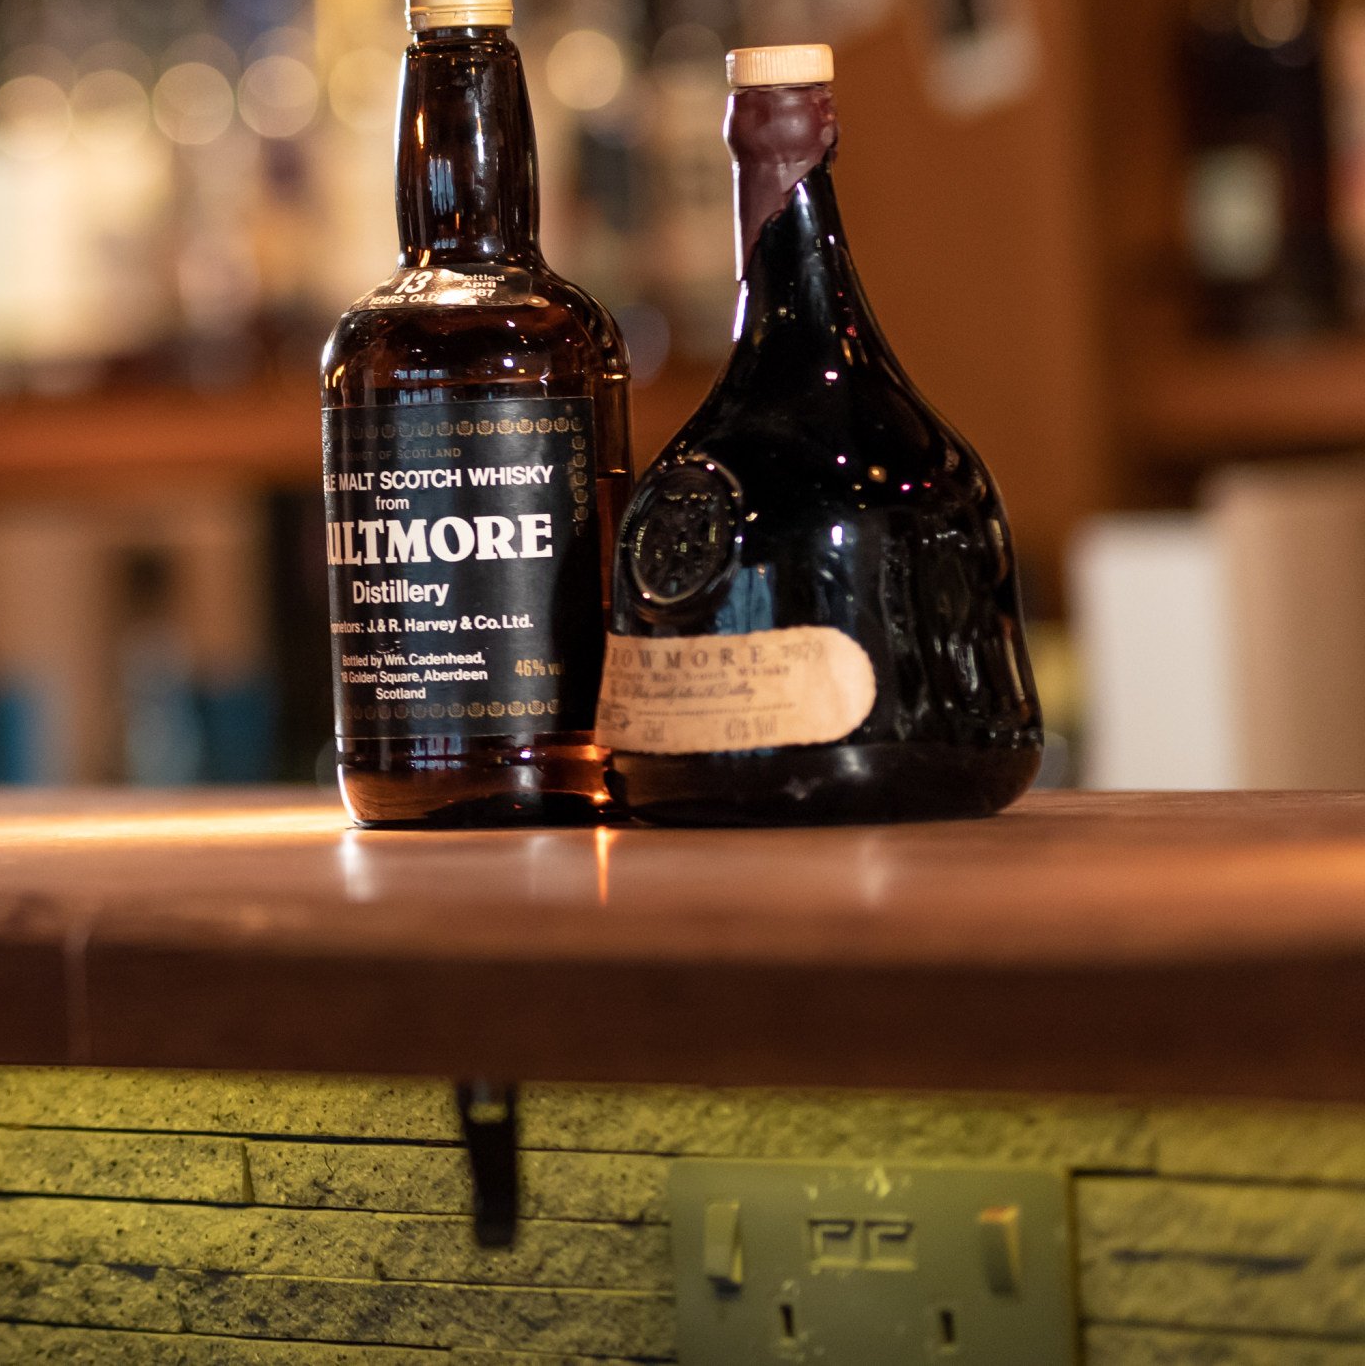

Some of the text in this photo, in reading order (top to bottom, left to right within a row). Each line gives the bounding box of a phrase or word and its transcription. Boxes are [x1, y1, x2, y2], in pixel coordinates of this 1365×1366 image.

[394, 270, 434, 294] 13
[462, 281, 497, 289] April
[409, 293, 439, 303] OLD
[467, 288, 497, 298] 987
[397, 447, 462, 460] SCOTLAND
[339, 472, 375, 491] MALT
[379, 469, 462, 490] SCOTCH
[468, 465, 554, 486] WHISKY
[375, 495, 410, 510] from
[327, 513, 554, 566] ULTMORE
[353, 579, 450, 607] Distillery
[389, 618, 402, 632] R.
[404, 617, 457, 633] Harvey
[460, 615, 473, 630] &
[370, 654, 382, 668] by
[384, 653, 408, 666] Wm.
[409, 652, 486, 666] Cadenhead,
[514, 658, 546, 677] 46%
[349, 671, 378, 683] Golden
[379, 670, 423, 685] Square,
[424, 668, 488, 682] Aberdeen
[375, 687, 427, 700] Scotland
